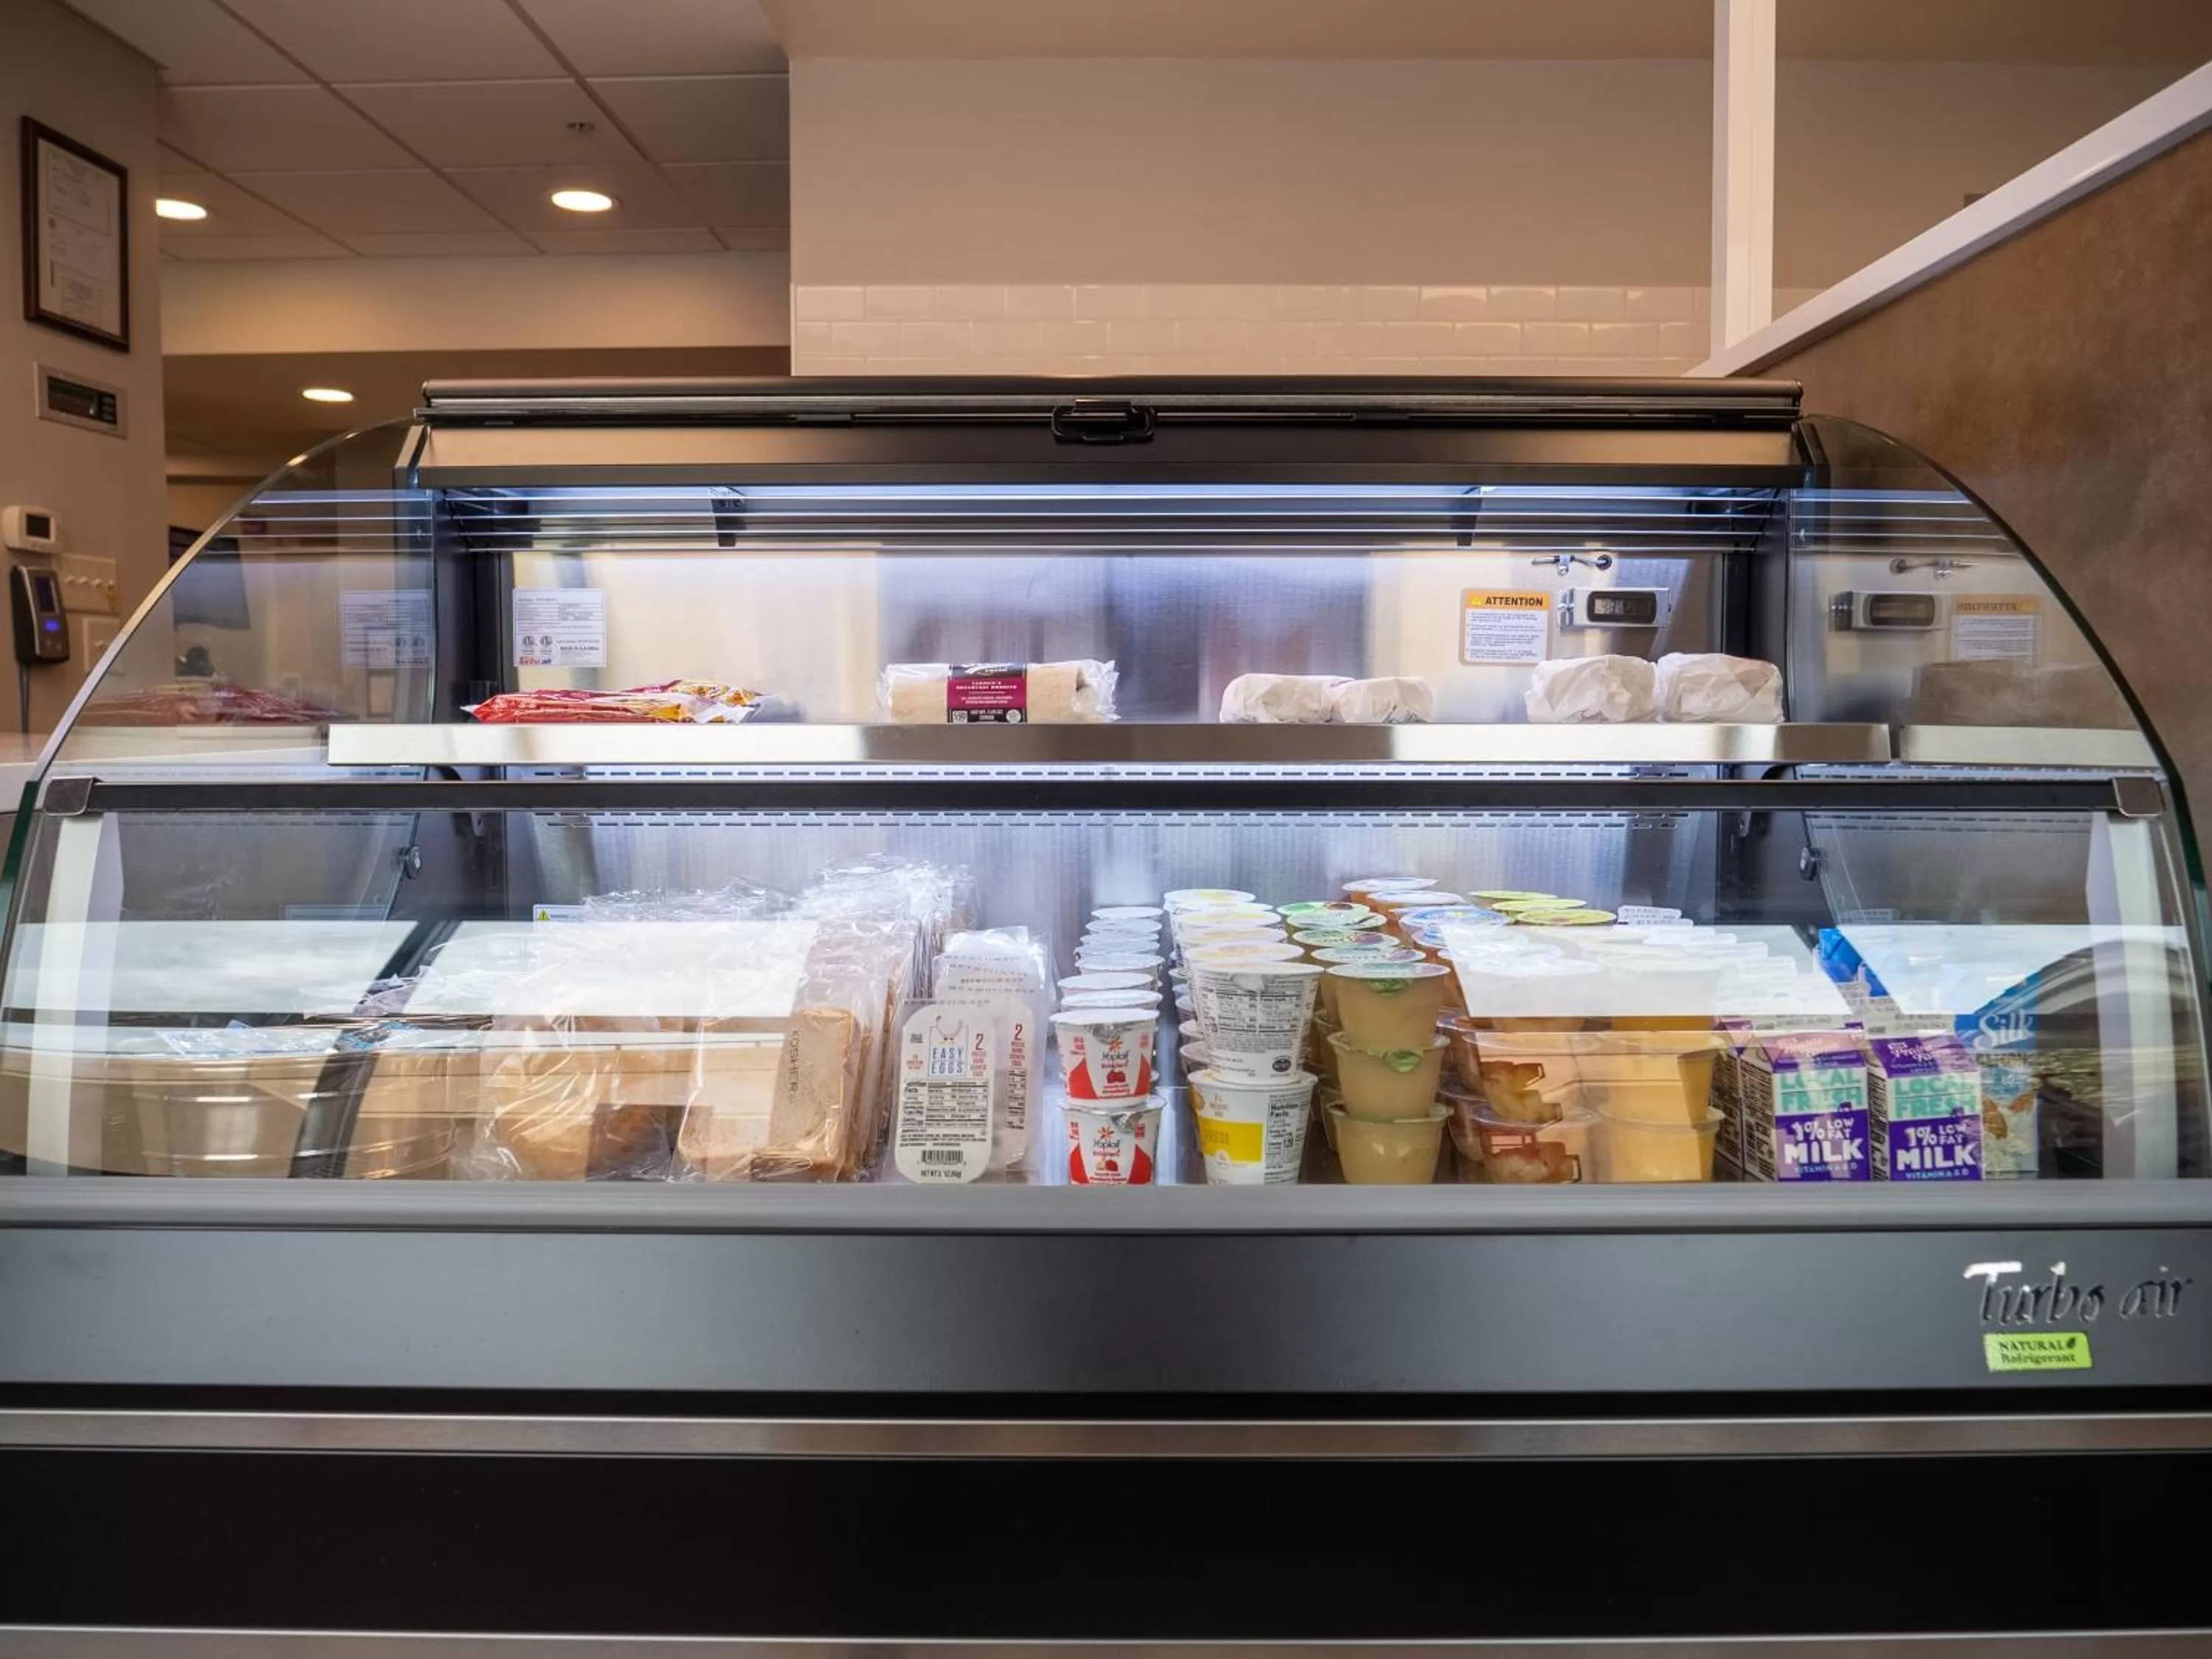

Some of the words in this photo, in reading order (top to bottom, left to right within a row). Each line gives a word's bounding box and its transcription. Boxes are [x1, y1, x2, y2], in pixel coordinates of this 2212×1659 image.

[1484, 596, 1543, 606] ATTENTION
[1014, 1023, 1023, 1041] 2
[1972, 1008, 2039, 1051] Silk
[975, 1032, 984, 1051] 2
[932, 1047, 964, 1060] EASY
[931, 1062, 963, 1074] EGGS
[1893, 1074, 1975, 1096] LOCAL
[1894, 1095, 1978, 1119] FRESH
[1791, 1118, 1824, 1141] 1%
[1826, 1116, 1855, 1130] LOW
[1827, 1127, 1852, 1140] FAT
[1905, 1124, 1938, 1147] 1%
[1938, 1122, 1969, 1135] LOW
[1939, 1133, 1965, 1146] FAT
[1783, 1137, 1865, 1165] MILK
[1896, 1142, 1977, 1172] MILK
[1963, 1260, 2105, 1326] Turbo
[2118, 1265, 2194, 1320] air
[1998, 1339, 2063, 1352] NATURAL
[2000, 1352, 2076, 1366] Refrigerant
